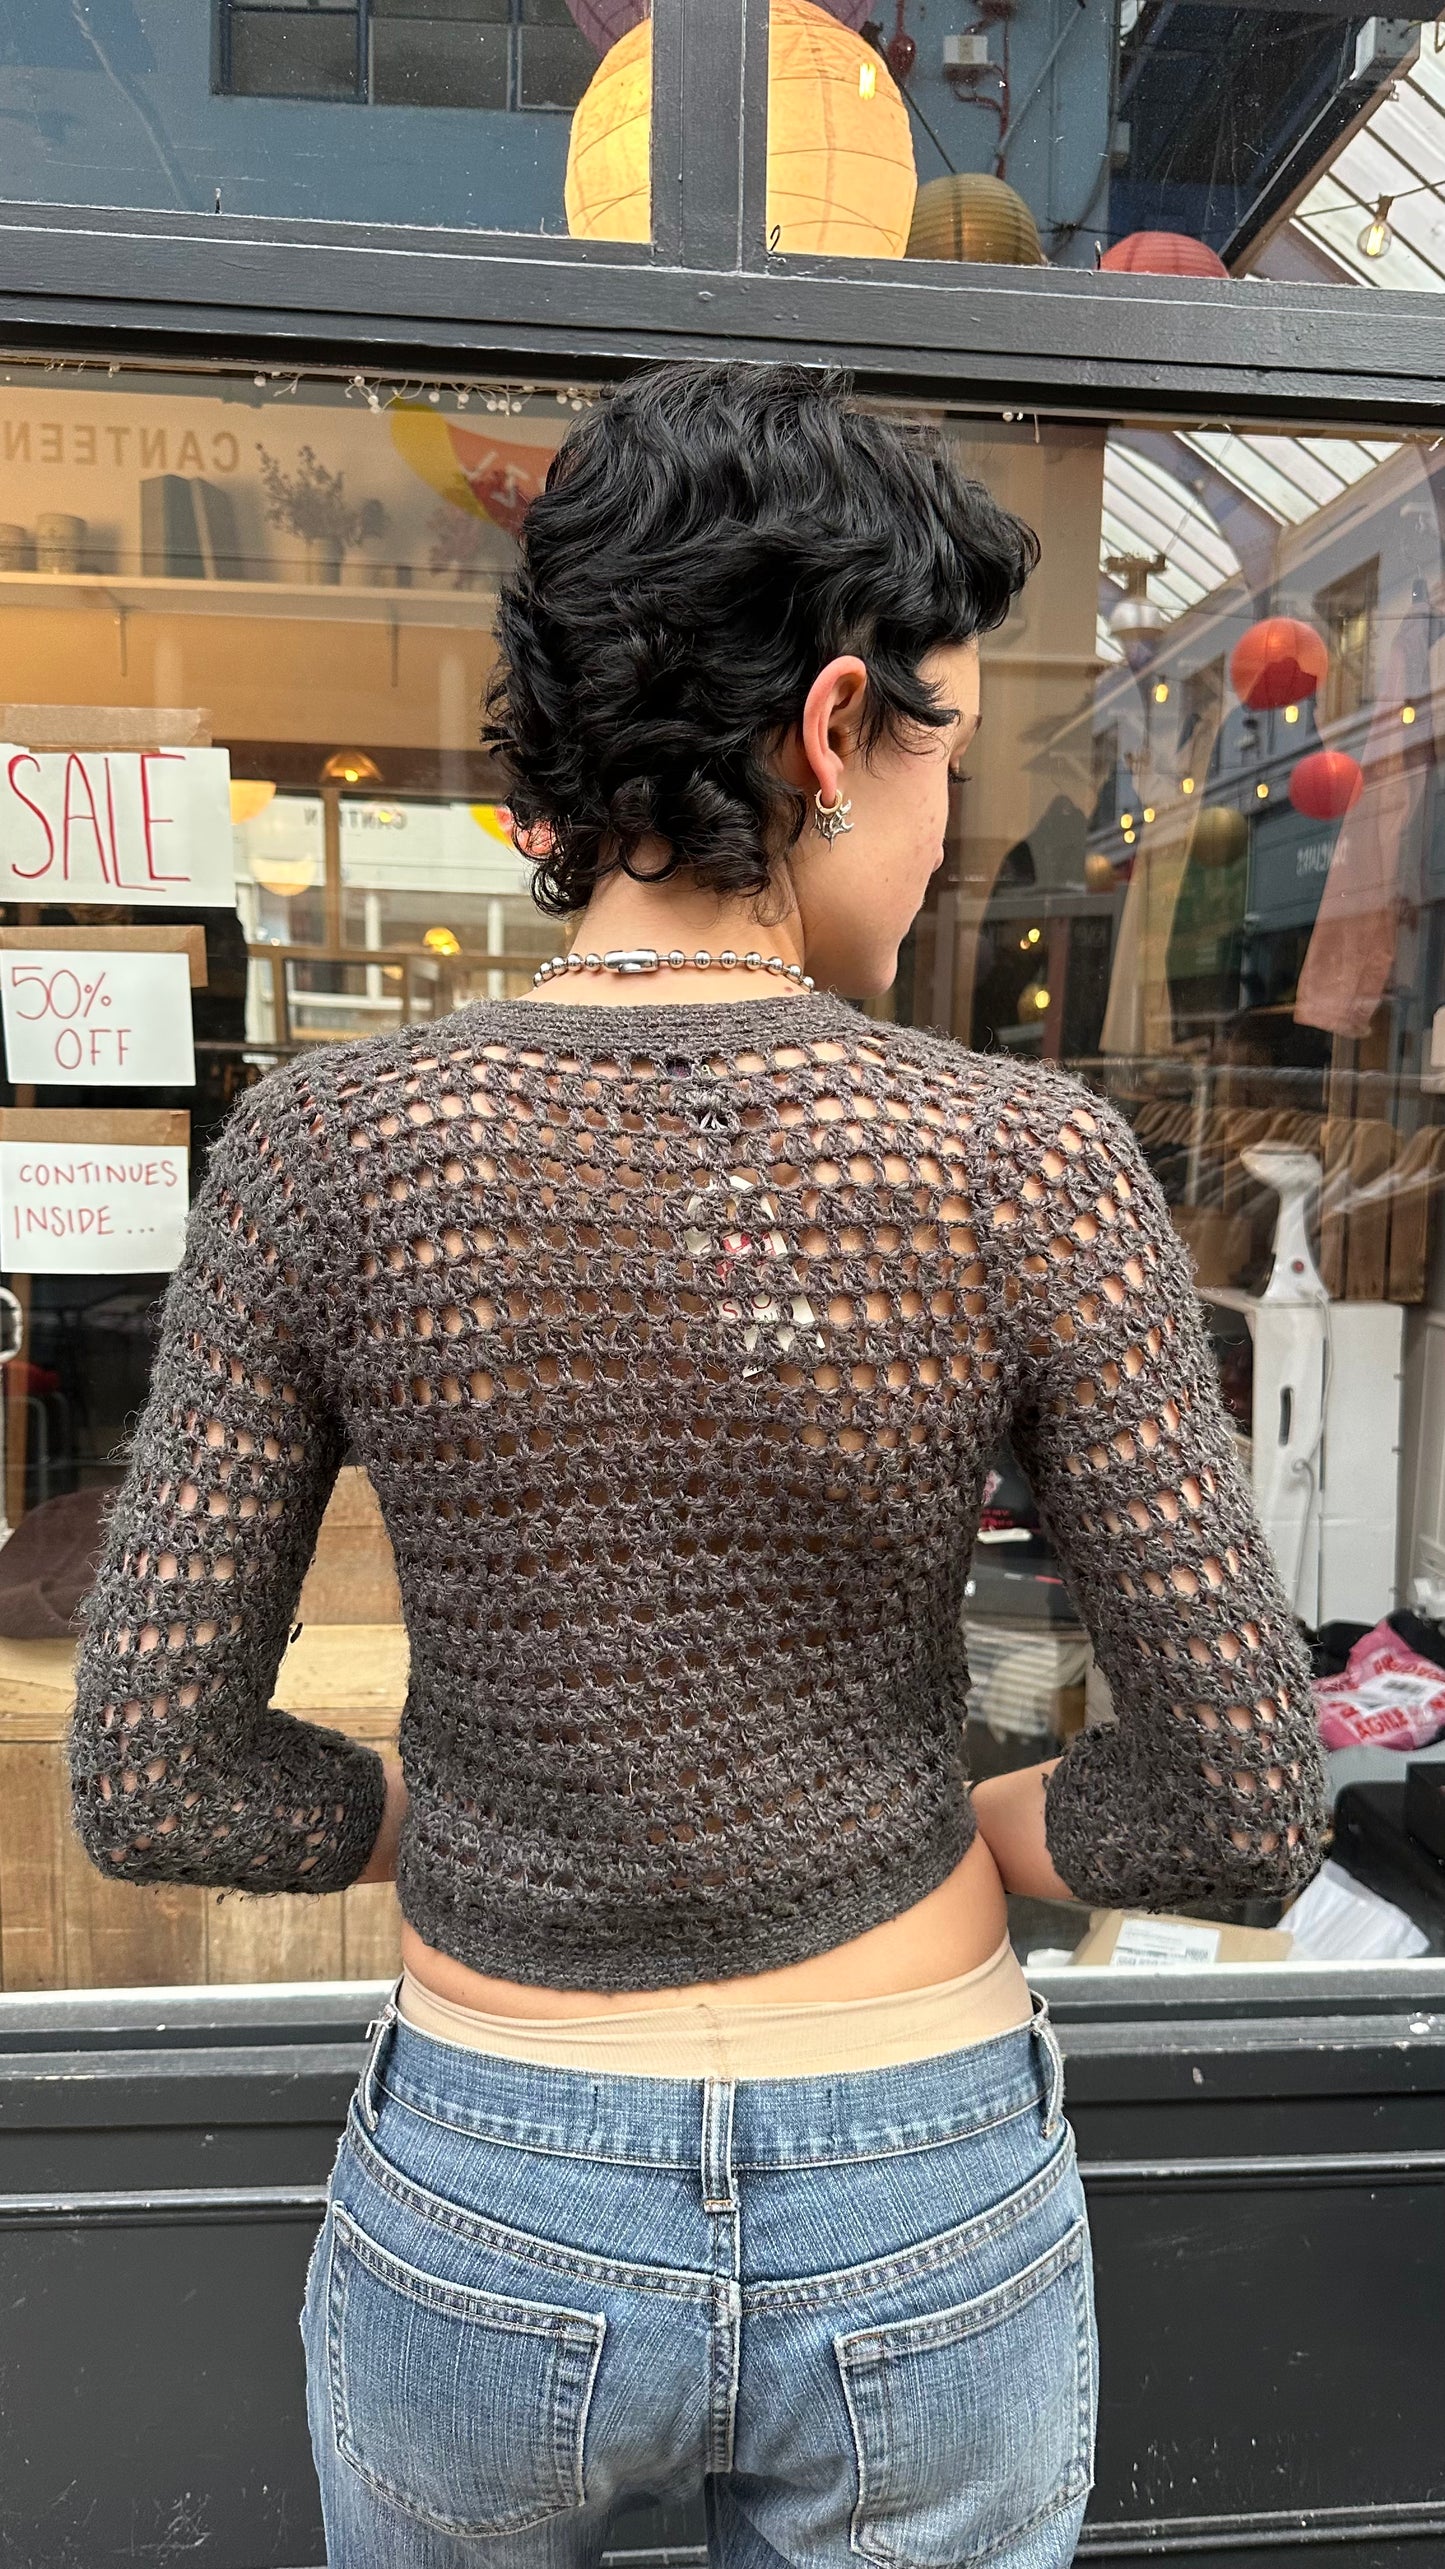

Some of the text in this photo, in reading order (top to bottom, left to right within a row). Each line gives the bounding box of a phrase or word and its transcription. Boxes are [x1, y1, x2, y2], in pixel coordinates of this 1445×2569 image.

[7, 753, 191, 892] SALE
[11, 966, 113, 1021] 50%
[54, 1028, 133, 1070] OFF
[19, 1160, 178, 1188] CONTINUES
